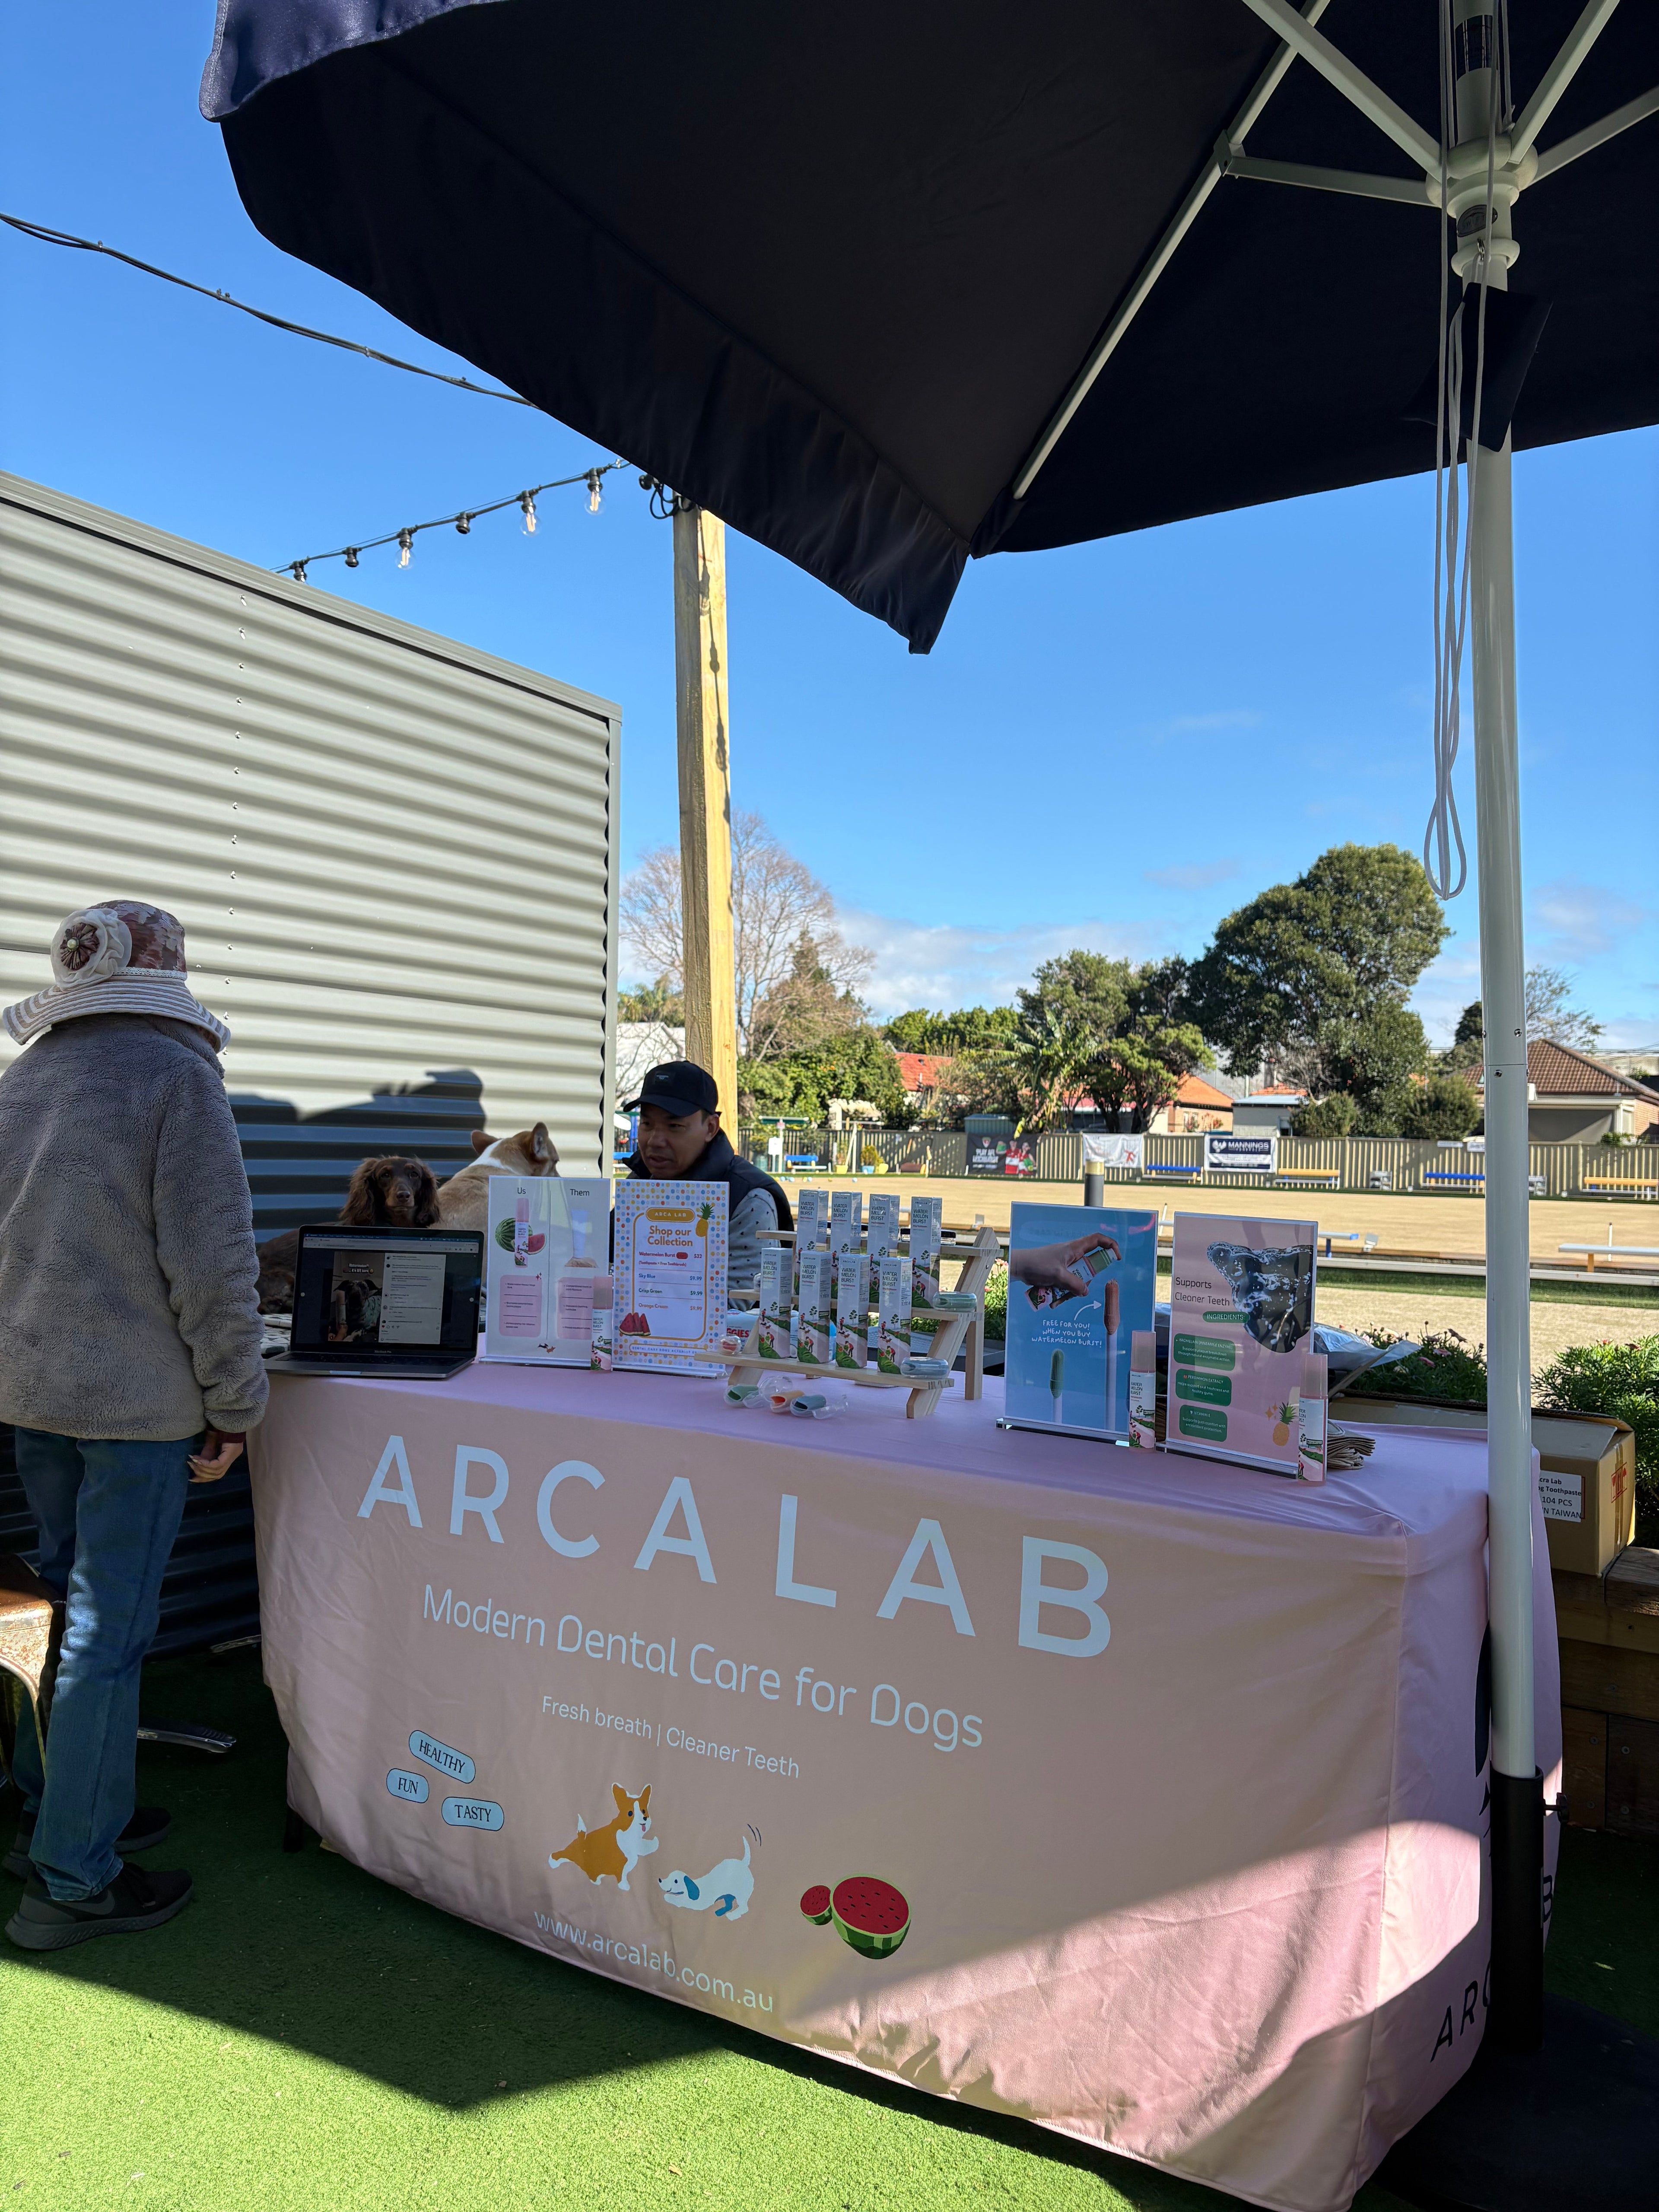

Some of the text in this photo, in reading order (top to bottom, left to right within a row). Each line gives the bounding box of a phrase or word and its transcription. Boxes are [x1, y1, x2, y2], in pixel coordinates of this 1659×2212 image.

[649, 1225, 672, 1237] Shop
[647, 1236, 693, 1246] Collection
[1176, 1277, 1212, 1288] Supports
[1175, 1292, 1230, 1306] Cleaner Teeth
[727, 1328, 749, 1338] GGIES
[1078, 1338, 1102, 1348] BURST!
[1546, 1486, 1581, 1496] Toothpaste
[1551, 1509, 1582, 1519] TAIWAN
[357, 1435, 1111, 1658] ARCA LAB
[423, 1584, 982, 1752] Modern Dental Care for Dogs
[542, 1696, 589, 1723] Fresh
[594, 1707, 651, 1739] breath
[667, 1727, 740, 1763] Cleaner
[745, 1746, 800, 1779] Teeth
[419, 1739, 465, 1773] HEALTHY
[398, 1777, 418, 1794] FUN
[454, 1805, 491, 1822] TASTY
[534, 1911, 773, 2013] www.arcalab.com.au
